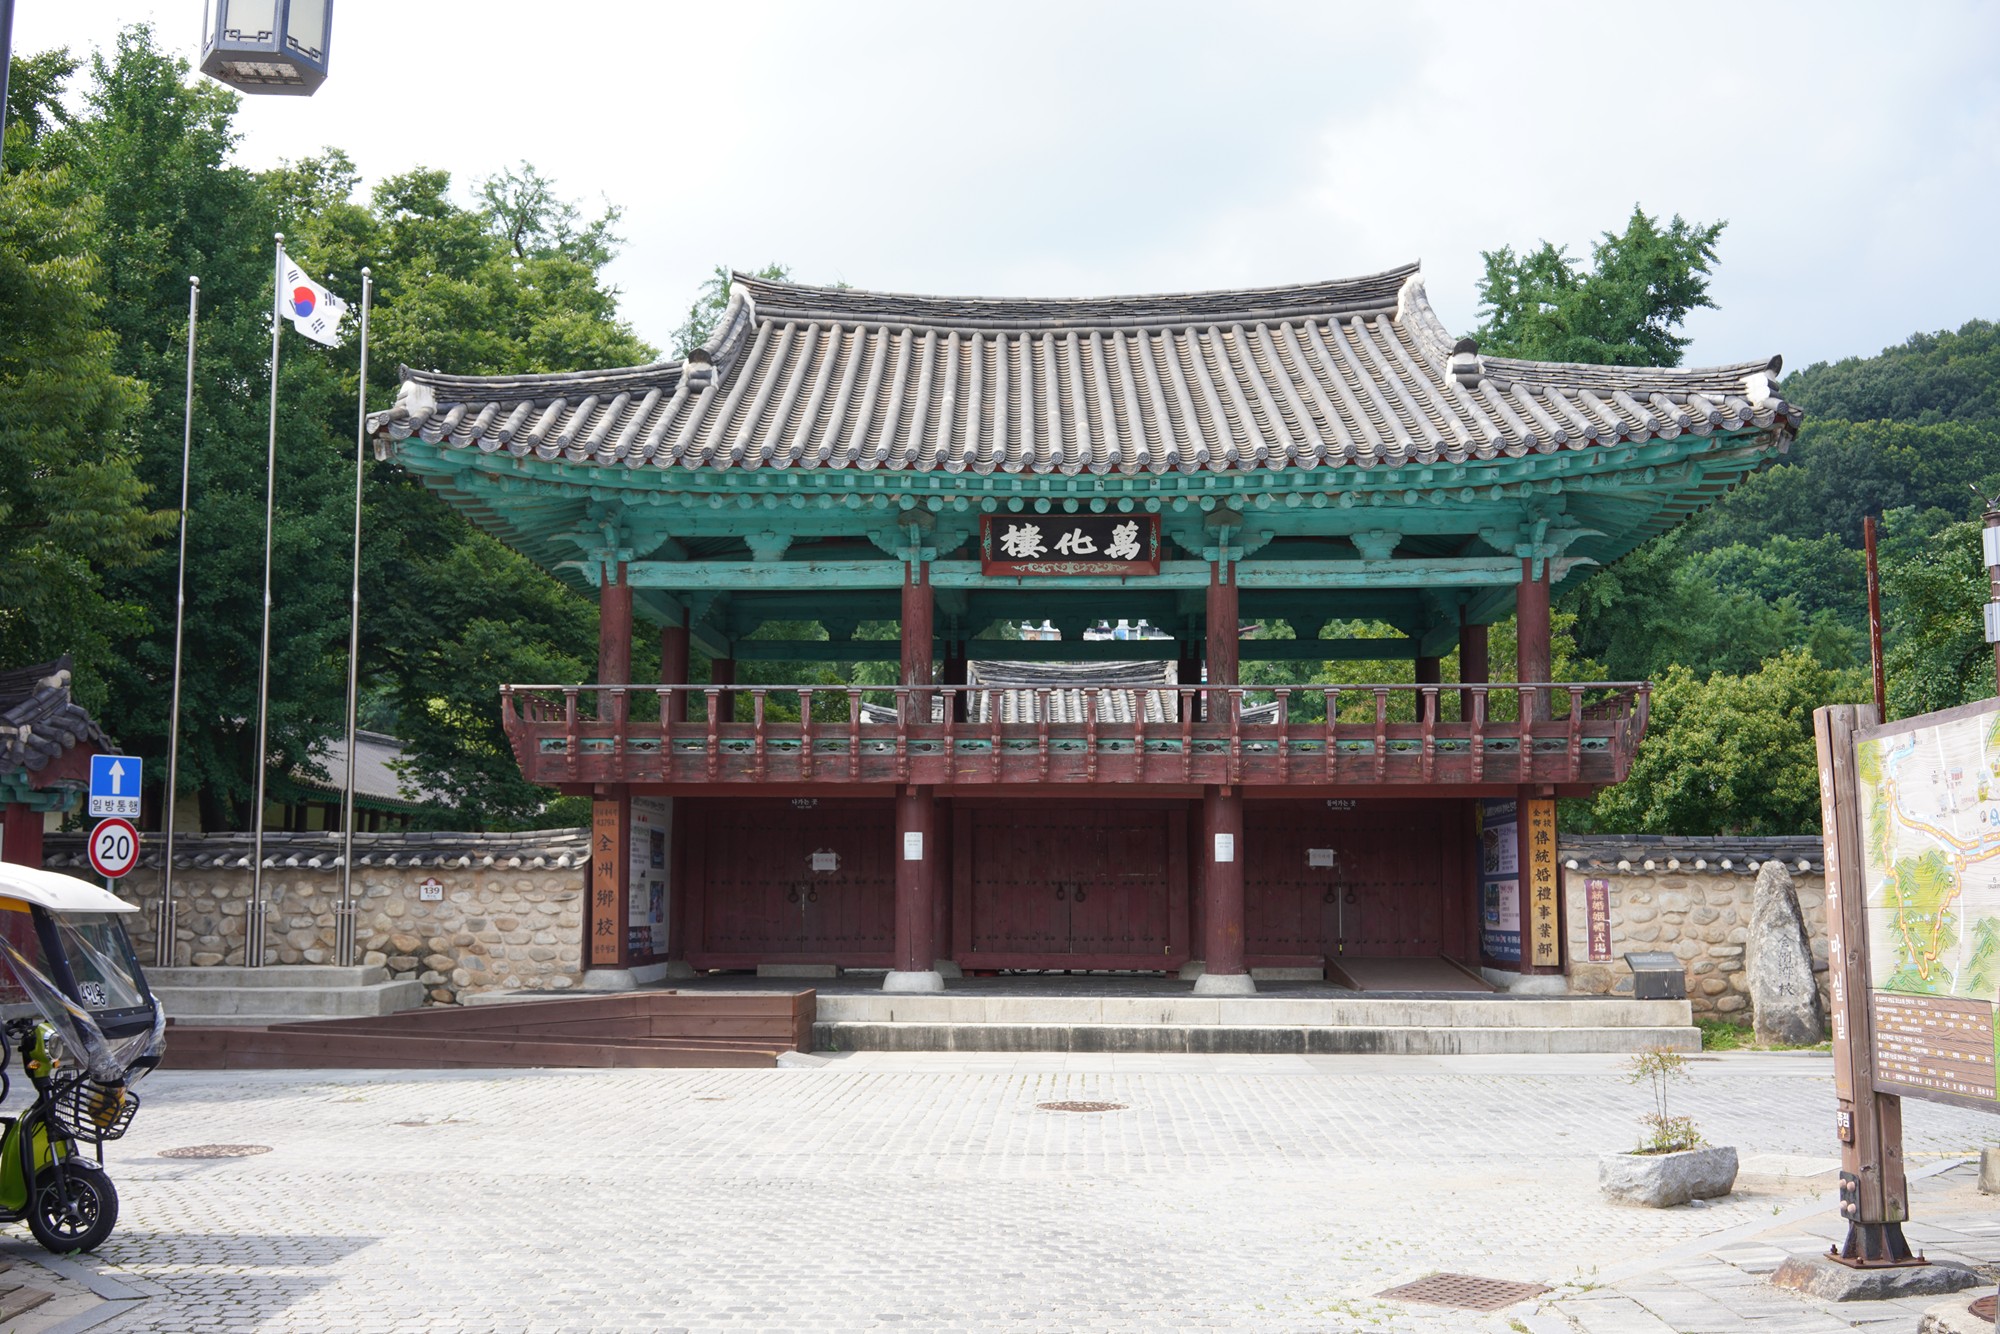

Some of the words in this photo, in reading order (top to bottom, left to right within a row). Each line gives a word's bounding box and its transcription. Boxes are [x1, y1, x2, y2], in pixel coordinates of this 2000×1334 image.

[92, 799, 138, 813] 일방통행
[101, 835, 130, 861] 20
[1822, 768, 1838, 909] 천년전주
[1831, 934, 1845, 1039] 마실길
[81, 983, 106, 1005] 4인용
